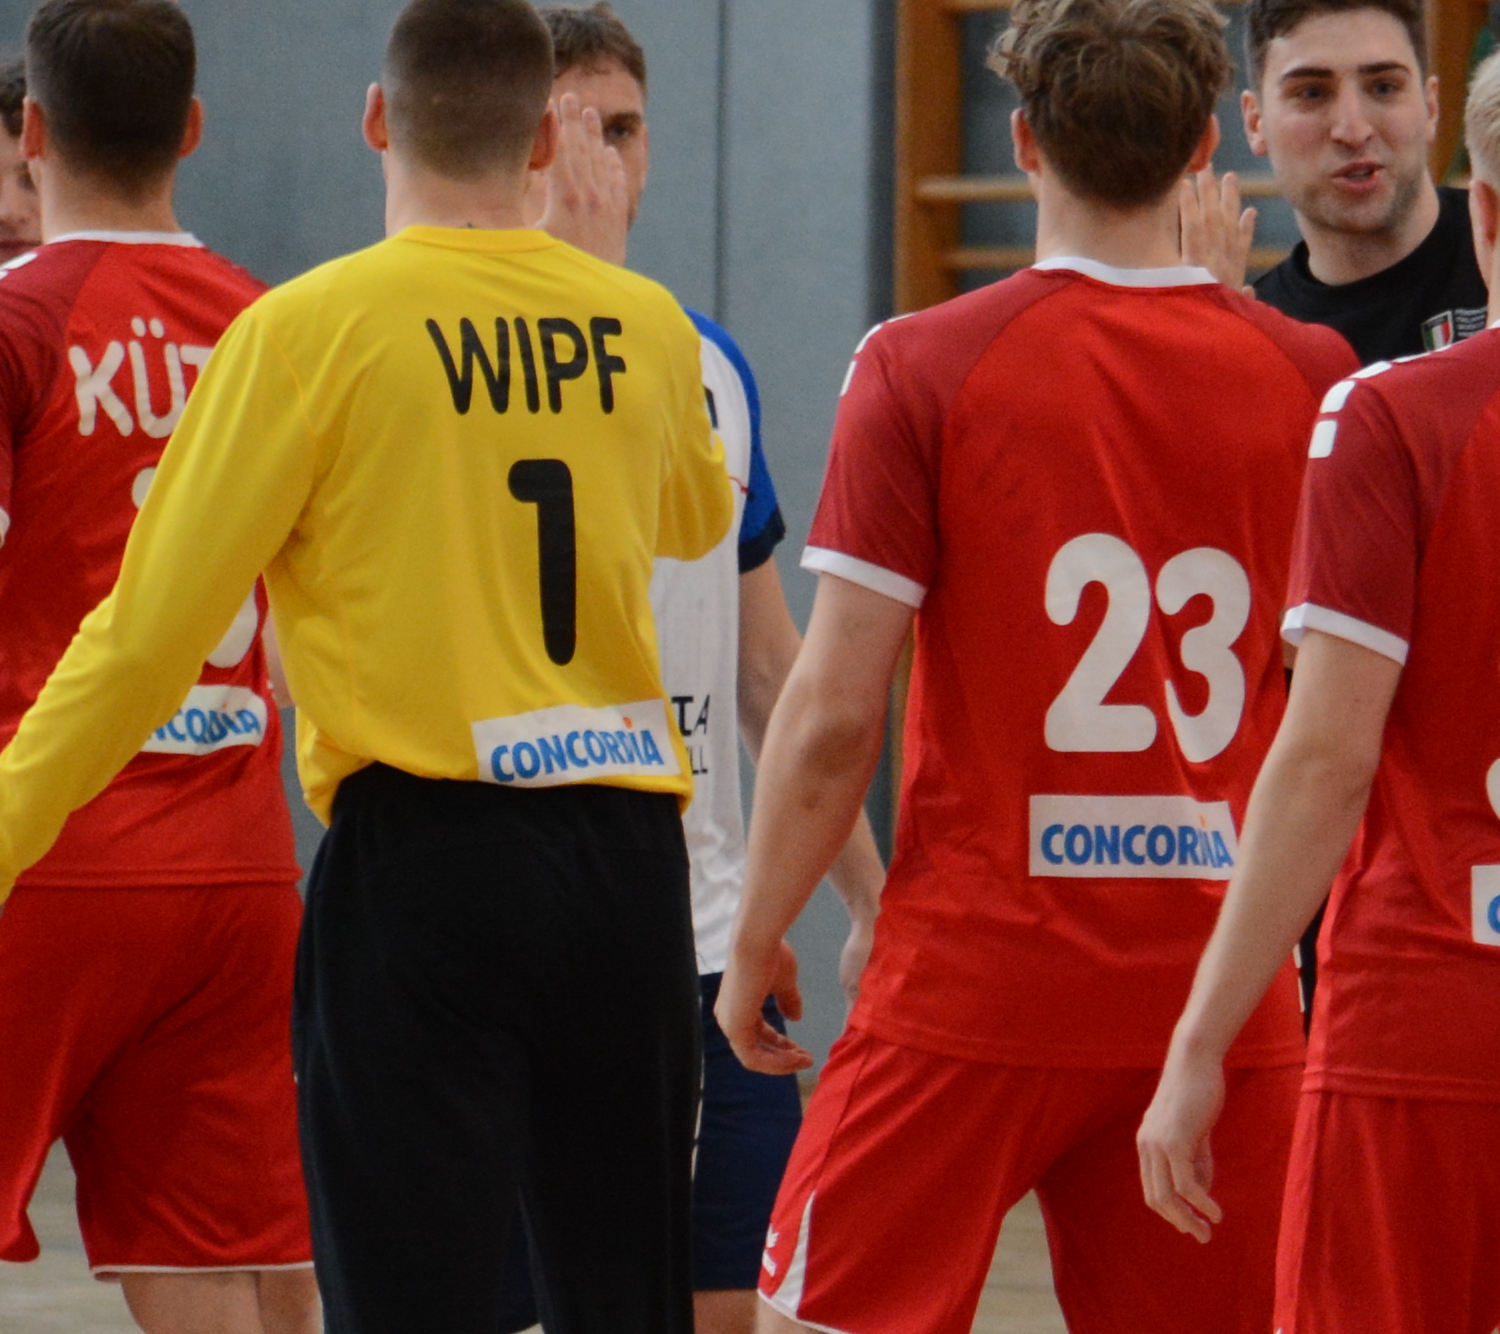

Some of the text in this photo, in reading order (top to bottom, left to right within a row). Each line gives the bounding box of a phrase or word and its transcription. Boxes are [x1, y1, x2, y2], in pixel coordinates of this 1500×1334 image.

[425, 316, 627, 416] WIPF
[509, 457, 578, 666] 1
[1045, 533, 1250, 763] 23
